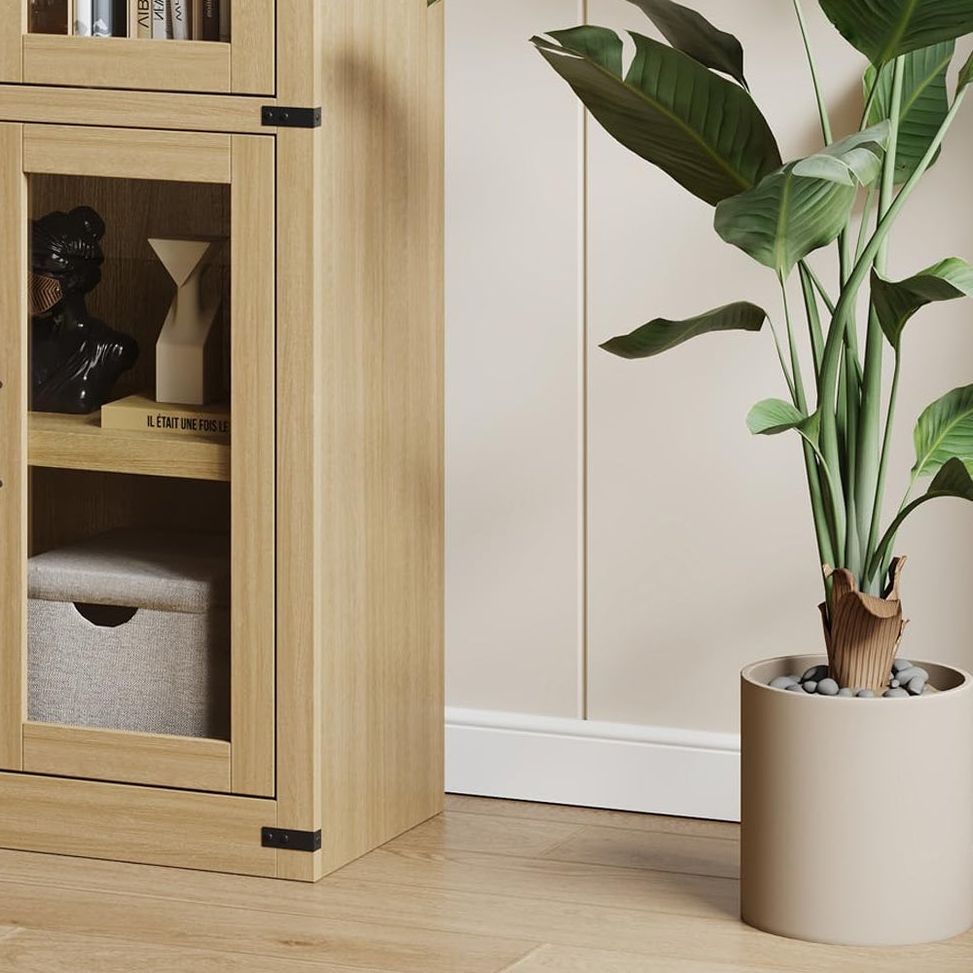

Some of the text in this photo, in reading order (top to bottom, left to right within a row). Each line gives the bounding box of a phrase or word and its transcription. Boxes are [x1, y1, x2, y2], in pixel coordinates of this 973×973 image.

[147, 415, 155, 427] IL
[156, 413, 179, 429] ÉTAIT
[181, 417, 197, 430] UNE
[199, 418, 217, 432] FOIS
